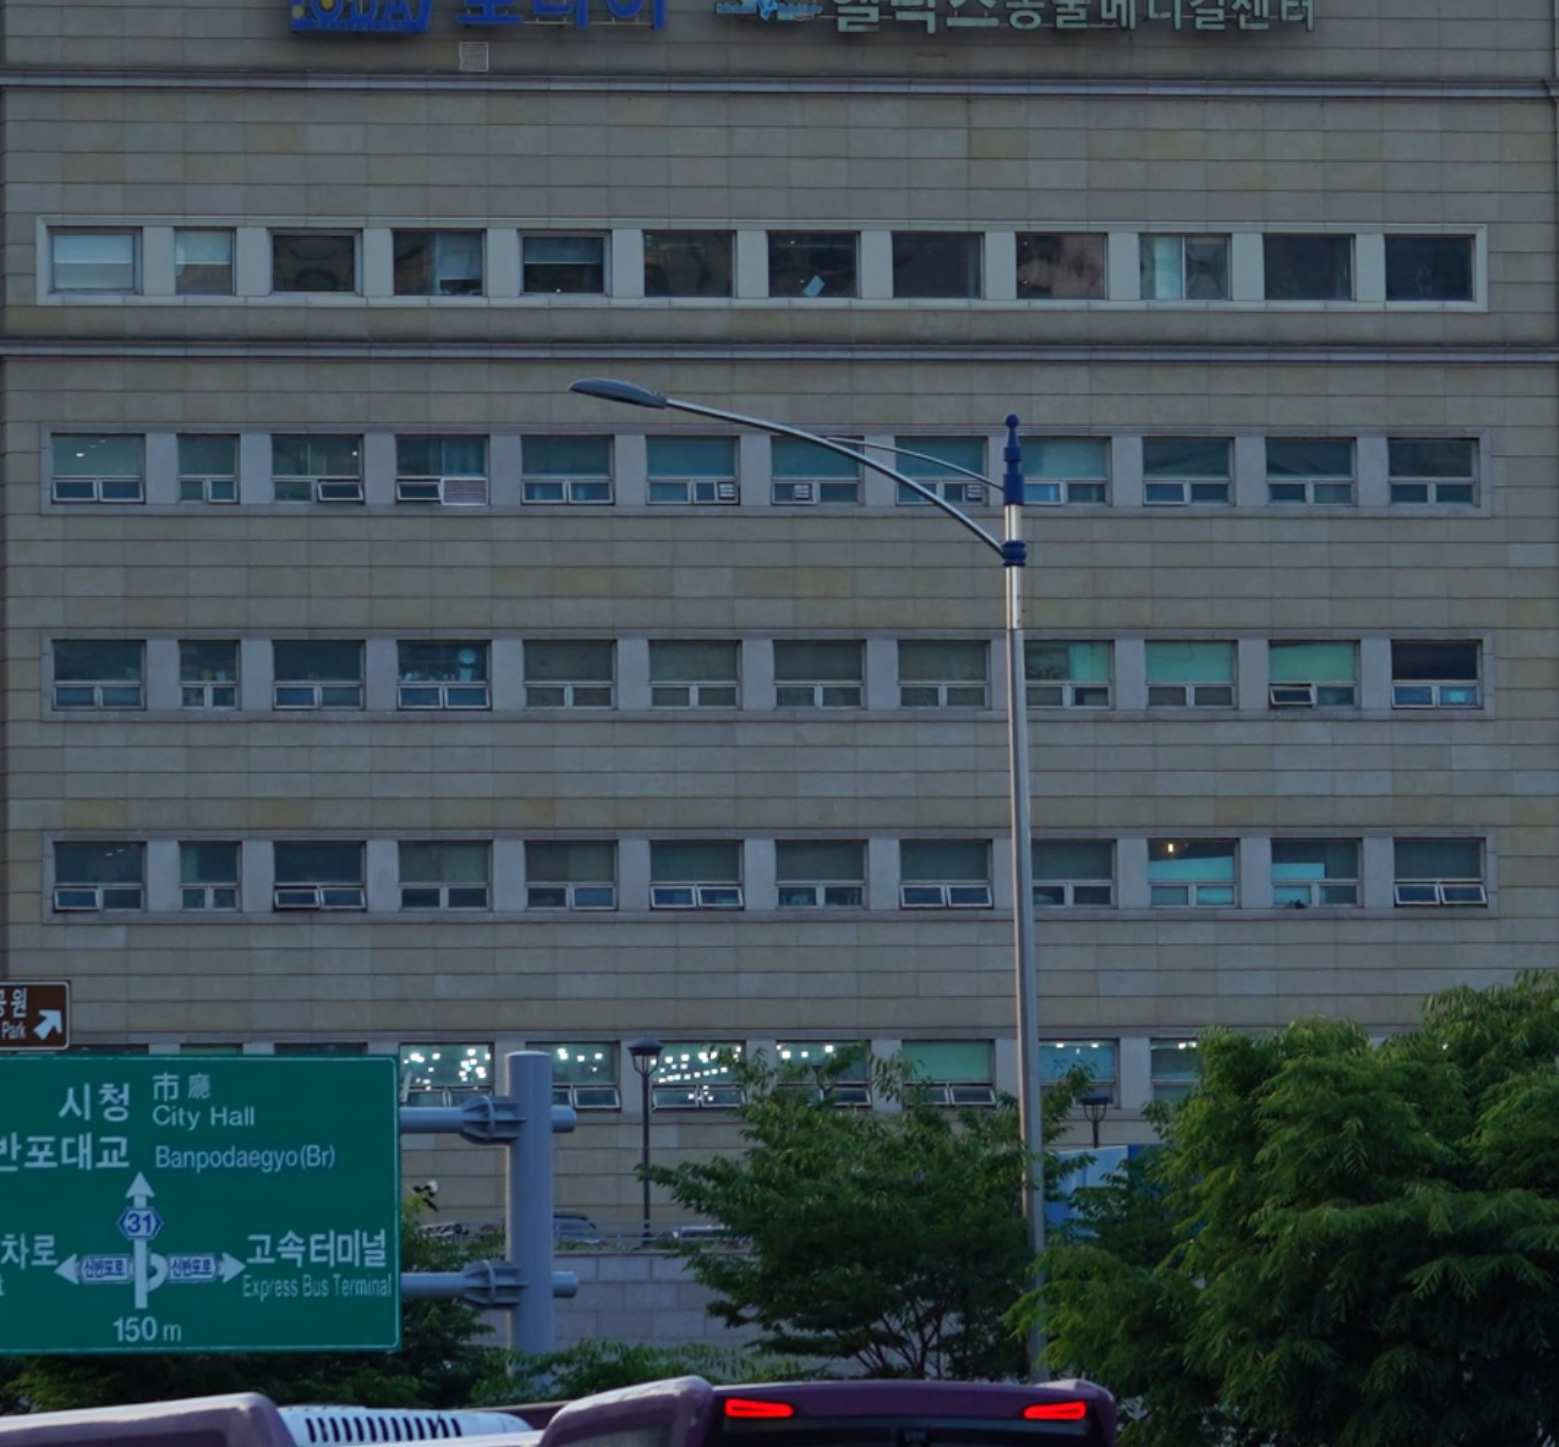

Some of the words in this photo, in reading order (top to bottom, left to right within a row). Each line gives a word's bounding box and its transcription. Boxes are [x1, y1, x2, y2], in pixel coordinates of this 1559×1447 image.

[2, 1021, 26, 1040] Park
[58, 1082, 130, 1122] 시청
[152, 1105, 200, 1131] City
[210, 1106, 255, 1126] Hall
[155, 1144, 336, 1173] Banpodaegyo(Br)
[127, 1213, 153, 1233] 31
[246, 1228, 387, 1268] 고속터미널
[84, 1258, 124, 1277] 신반포로
[171, 1258, 211, 1276] 신반포로
[242, 1275, 299, 1302] Express
[303, 1274, 329, 1297] Bus
[332, 1273, 392, 1297] Terminal
[113, 1316, 157, 1342] 150
[163, 1323, 182, 1341] m
